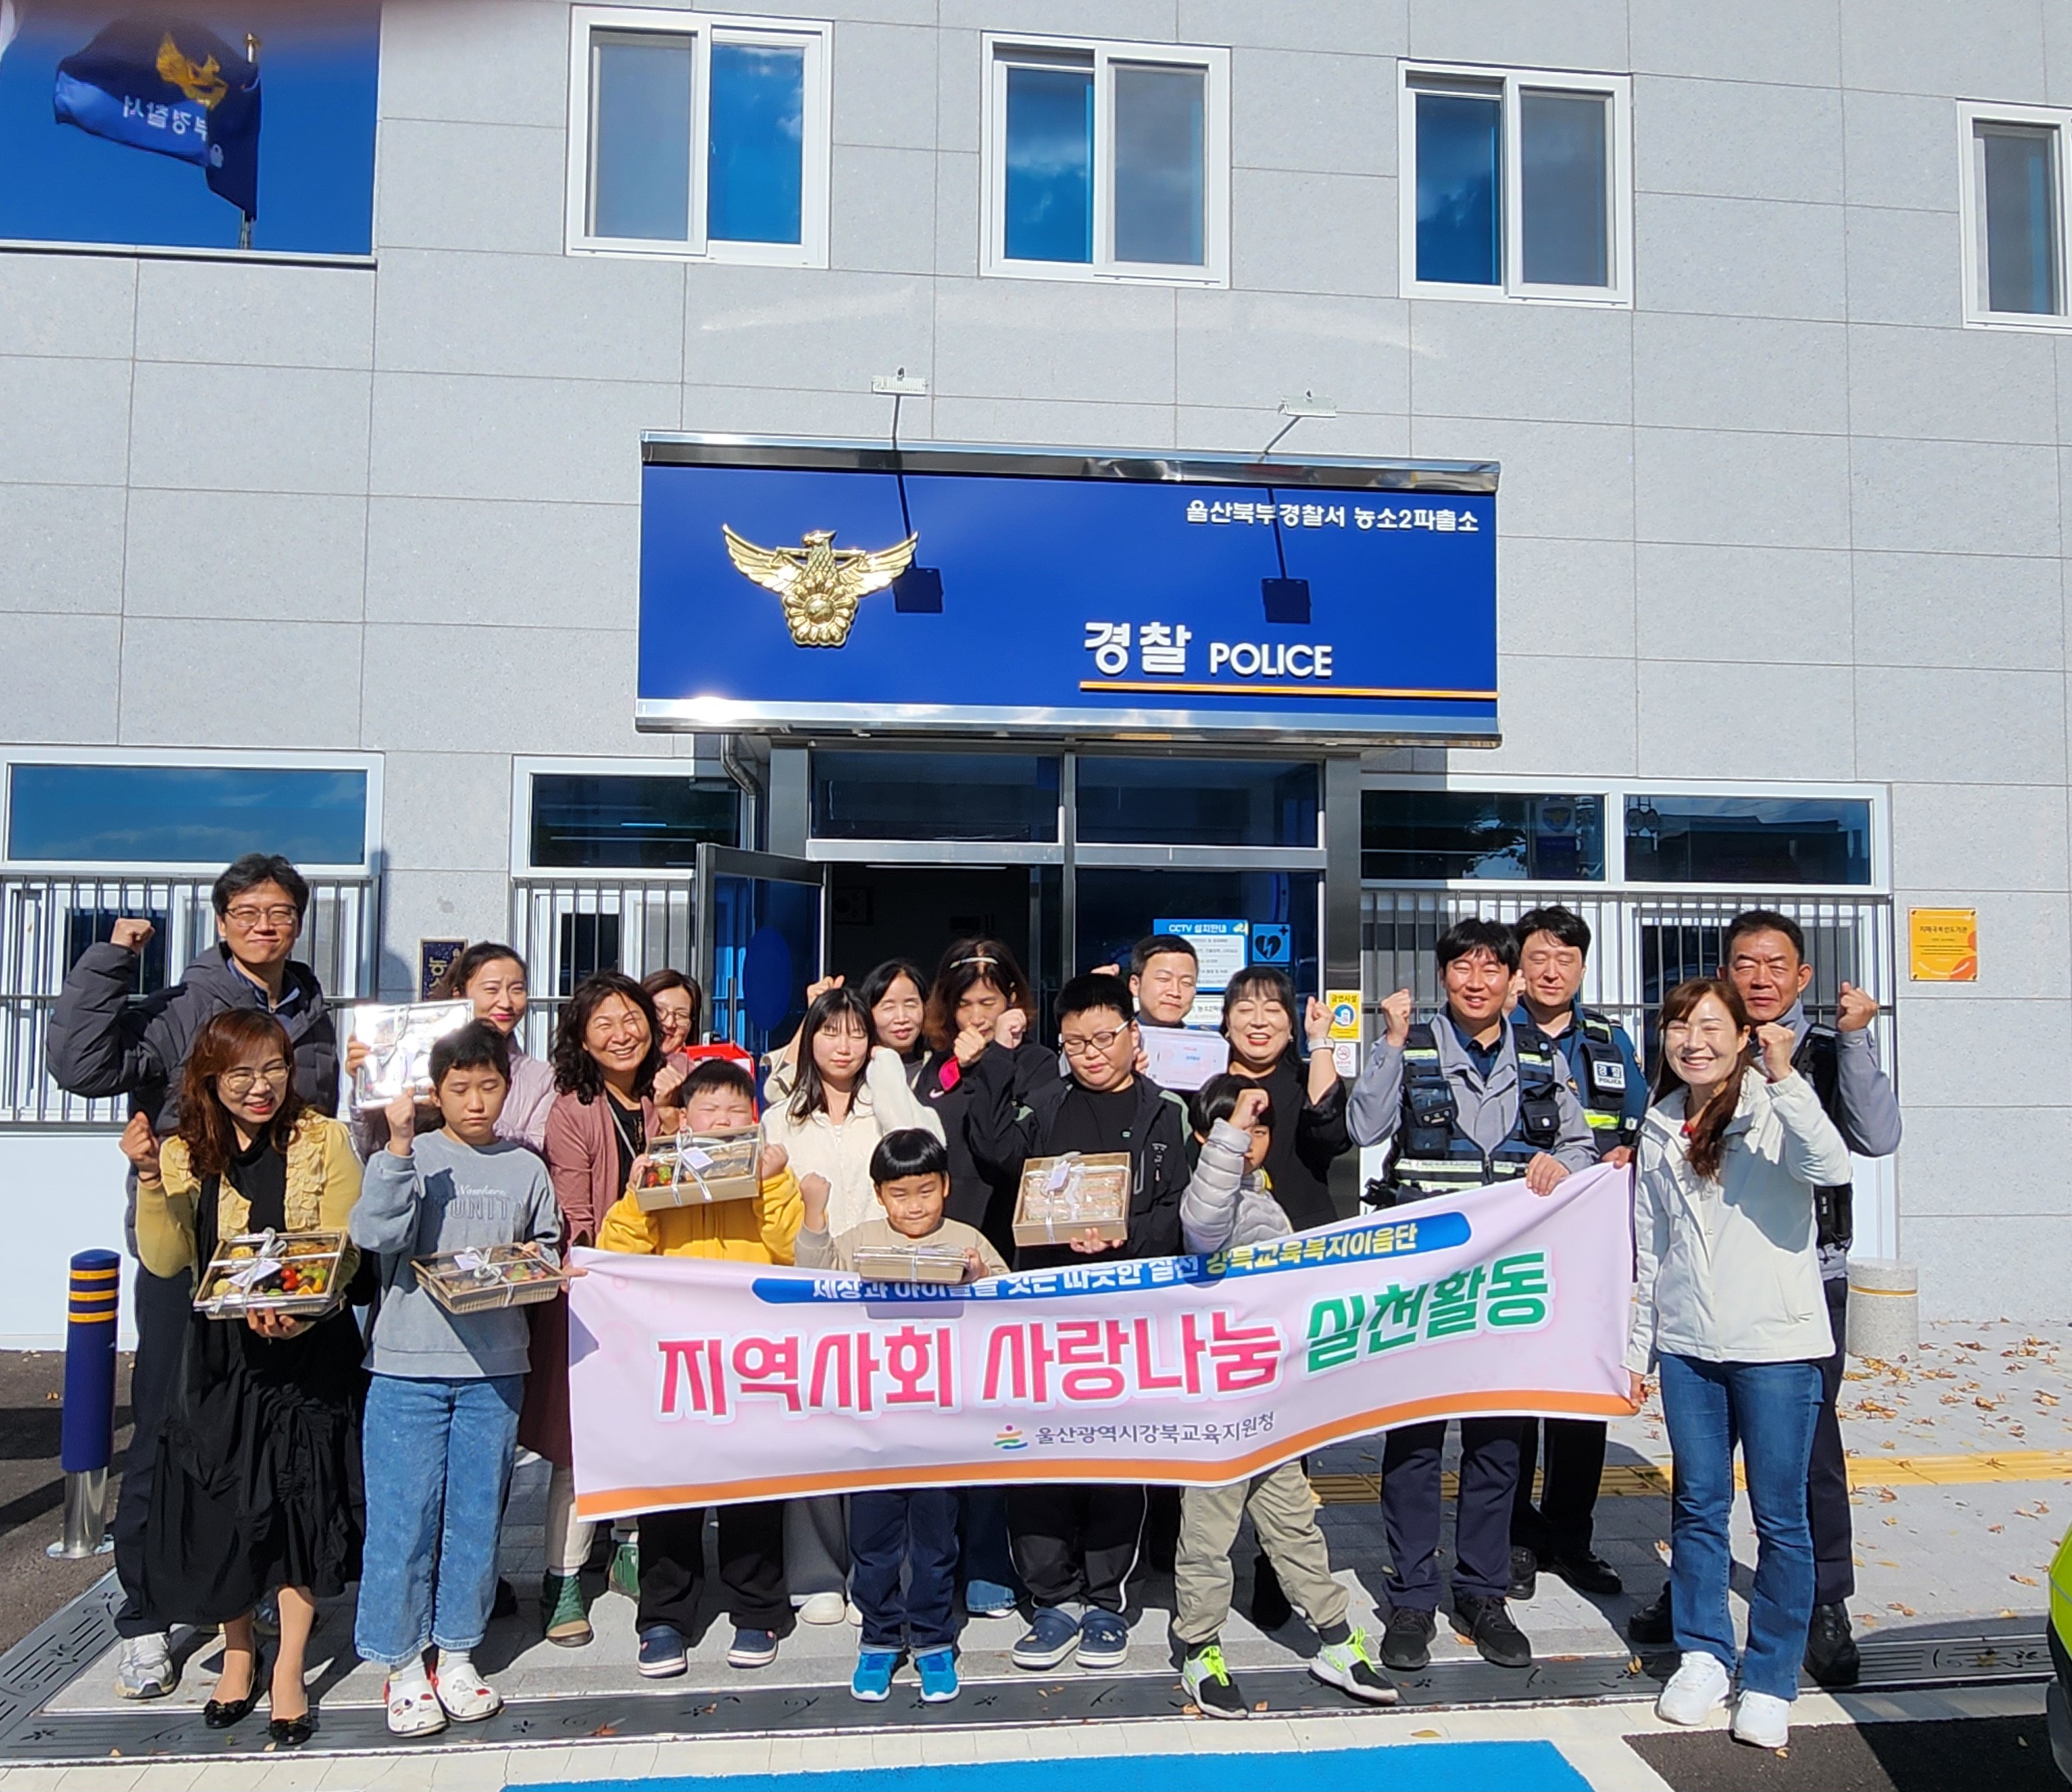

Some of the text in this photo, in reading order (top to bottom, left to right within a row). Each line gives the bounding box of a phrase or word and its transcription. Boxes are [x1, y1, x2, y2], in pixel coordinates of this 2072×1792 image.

[1187, 500, 1479, 531] 울산북부경찰서 농소2파출소
[1084, 622, 1333, 677] 경찰 POLICE
[1169, 924, 1192, 933] CCTV
[658, 1252, 1549, 1416] 지역사회 사랑나눔 실천활동
[1035, 1412, 1275, 1445] 울산광역시강북교육지원청
